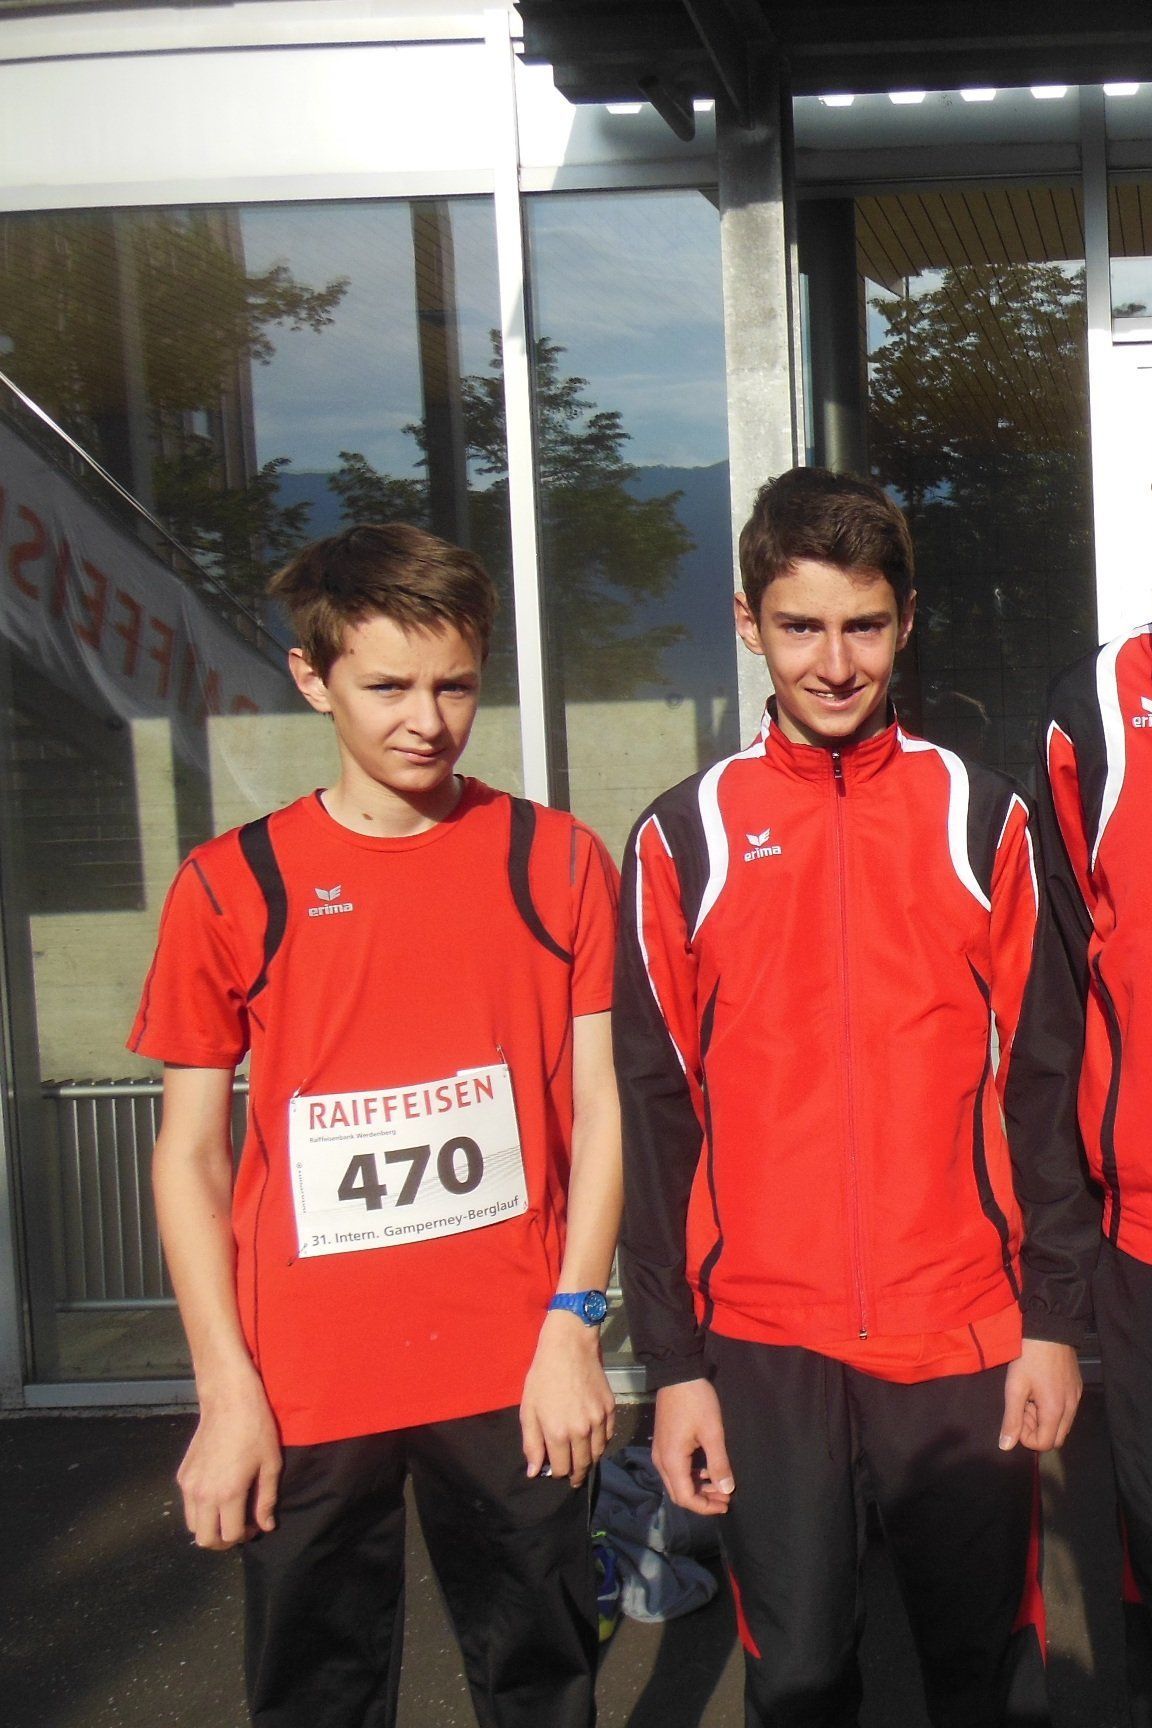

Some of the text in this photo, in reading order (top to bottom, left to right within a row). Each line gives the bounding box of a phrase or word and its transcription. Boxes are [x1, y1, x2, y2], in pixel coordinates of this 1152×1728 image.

[744, 846, 782, 862] erima
[309, 903, 353, 917] erima
[309, 1075, 494, 1130] RAIFFEISEN
[337, 1136, 484, 1211] 470
[312, 1195, 519, 1246] 31. Intern. Gamperney-Berglauf
